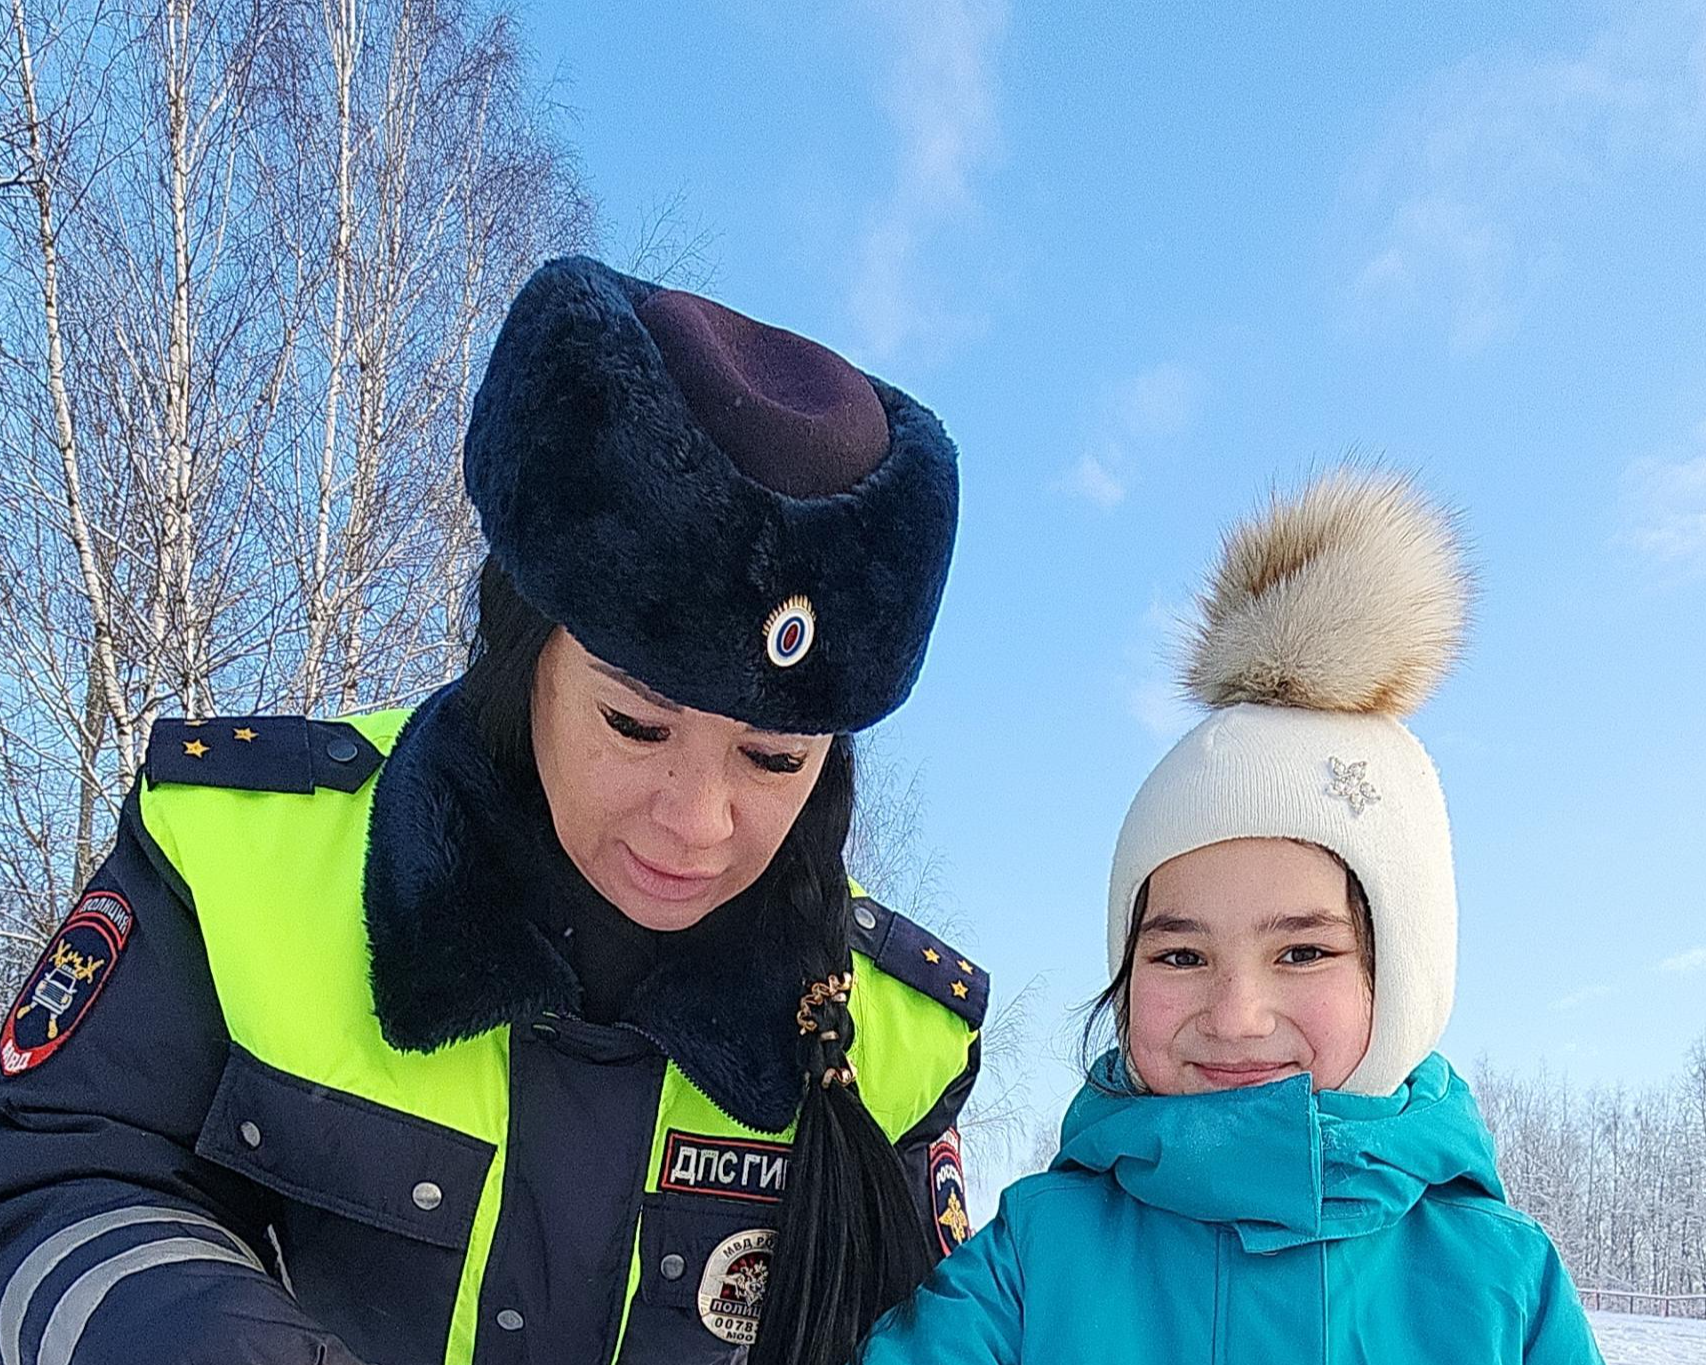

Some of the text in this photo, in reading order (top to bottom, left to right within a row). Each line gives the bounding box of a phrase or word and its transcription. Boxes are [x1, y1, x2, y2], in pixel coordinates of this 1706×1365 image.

[670, 1146, 788, 1191] ДПС ГИ
[723, 1238, 753, 1258] МВД
